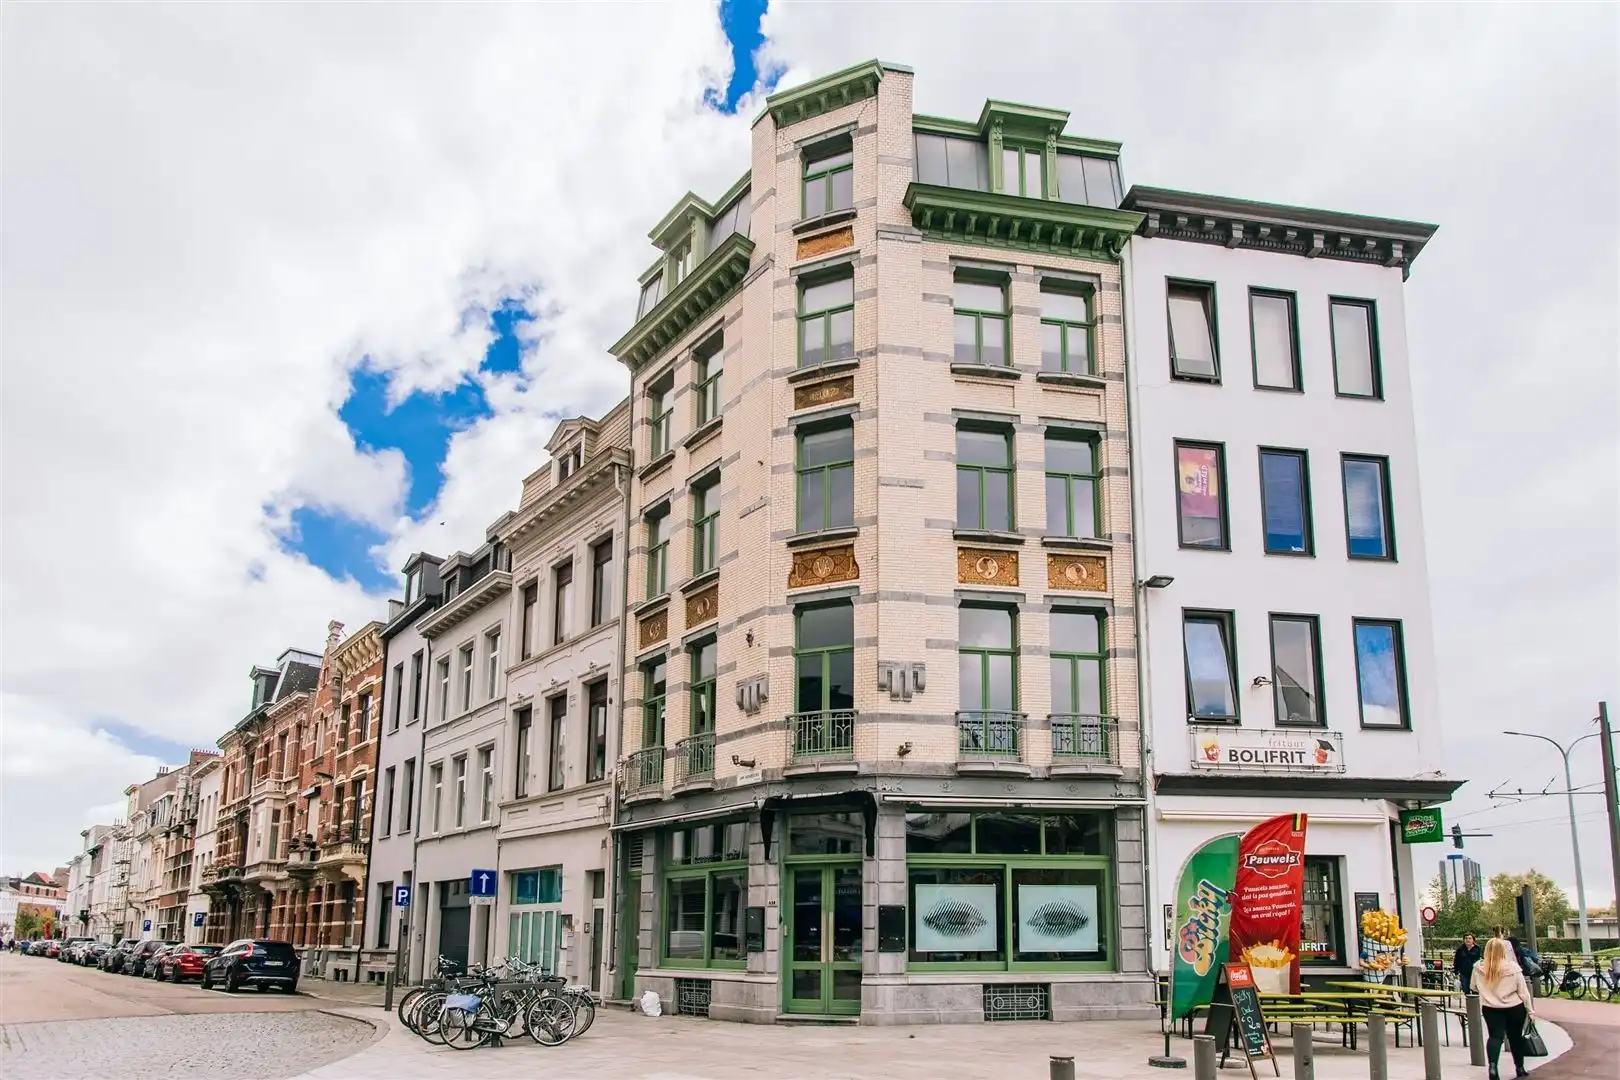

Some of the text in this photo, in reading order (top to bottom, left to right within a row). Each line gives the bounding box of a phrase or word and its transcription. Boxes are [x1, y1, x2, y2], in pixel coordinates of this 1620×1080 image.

[1228, 749, 1307, 764] BOLIFRIT
[1249, 853, 1295, 865] Pauwels
[397, 889, 408, 903] P
[1299, 942, 1328, 952] IFRIT
